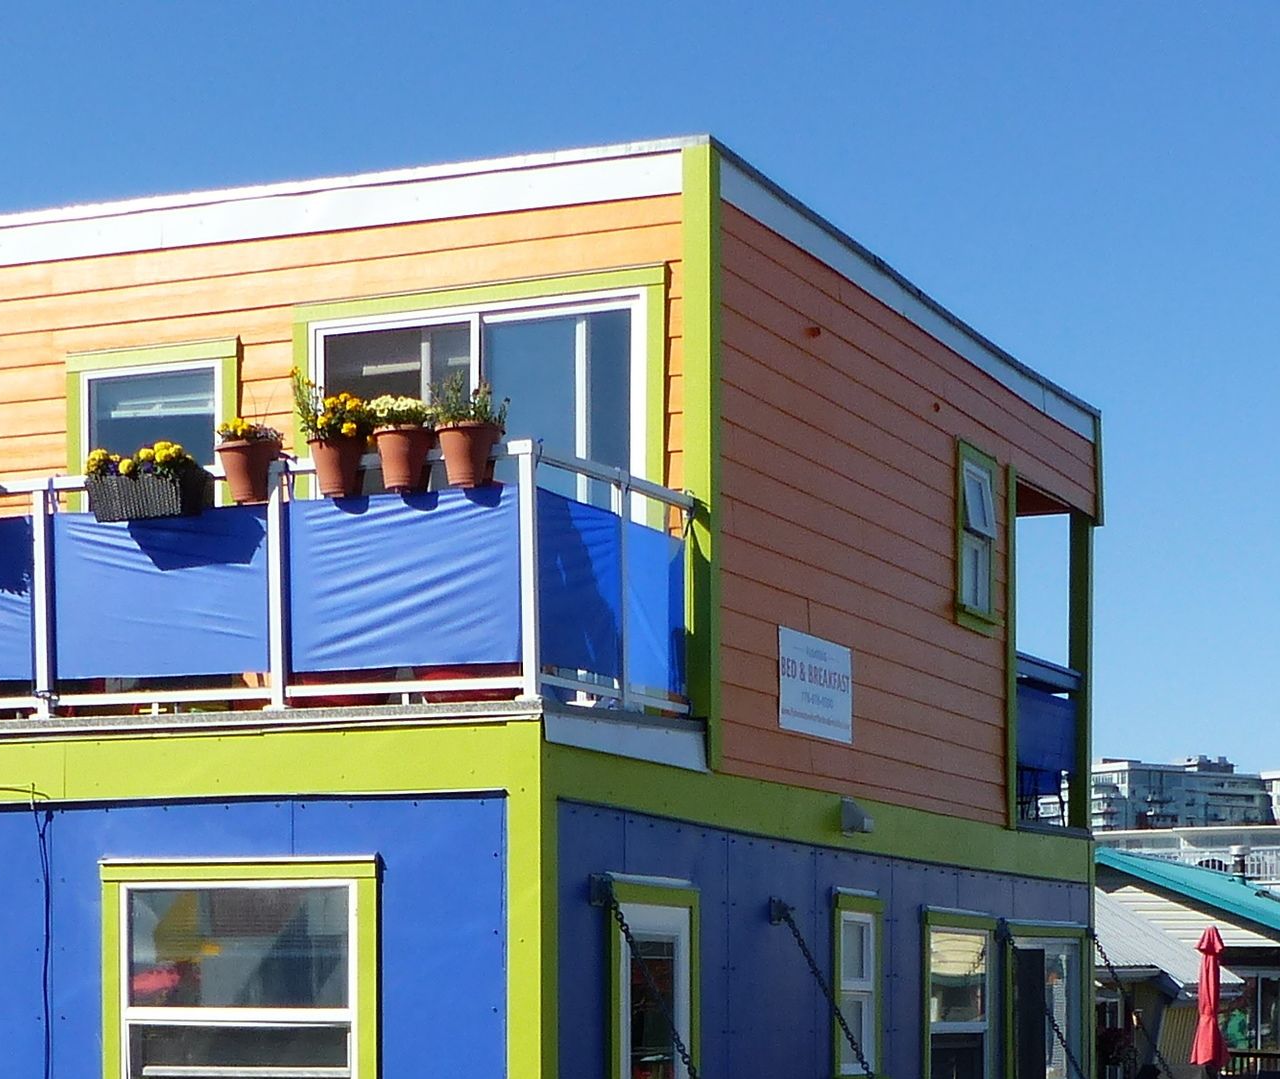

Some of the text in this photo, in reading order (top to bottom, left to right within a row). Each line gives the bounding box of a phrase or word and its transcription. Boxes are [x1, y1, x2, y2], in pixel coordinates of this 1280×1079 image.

[781, 656, 850, 694] BED & BREAKFAST
